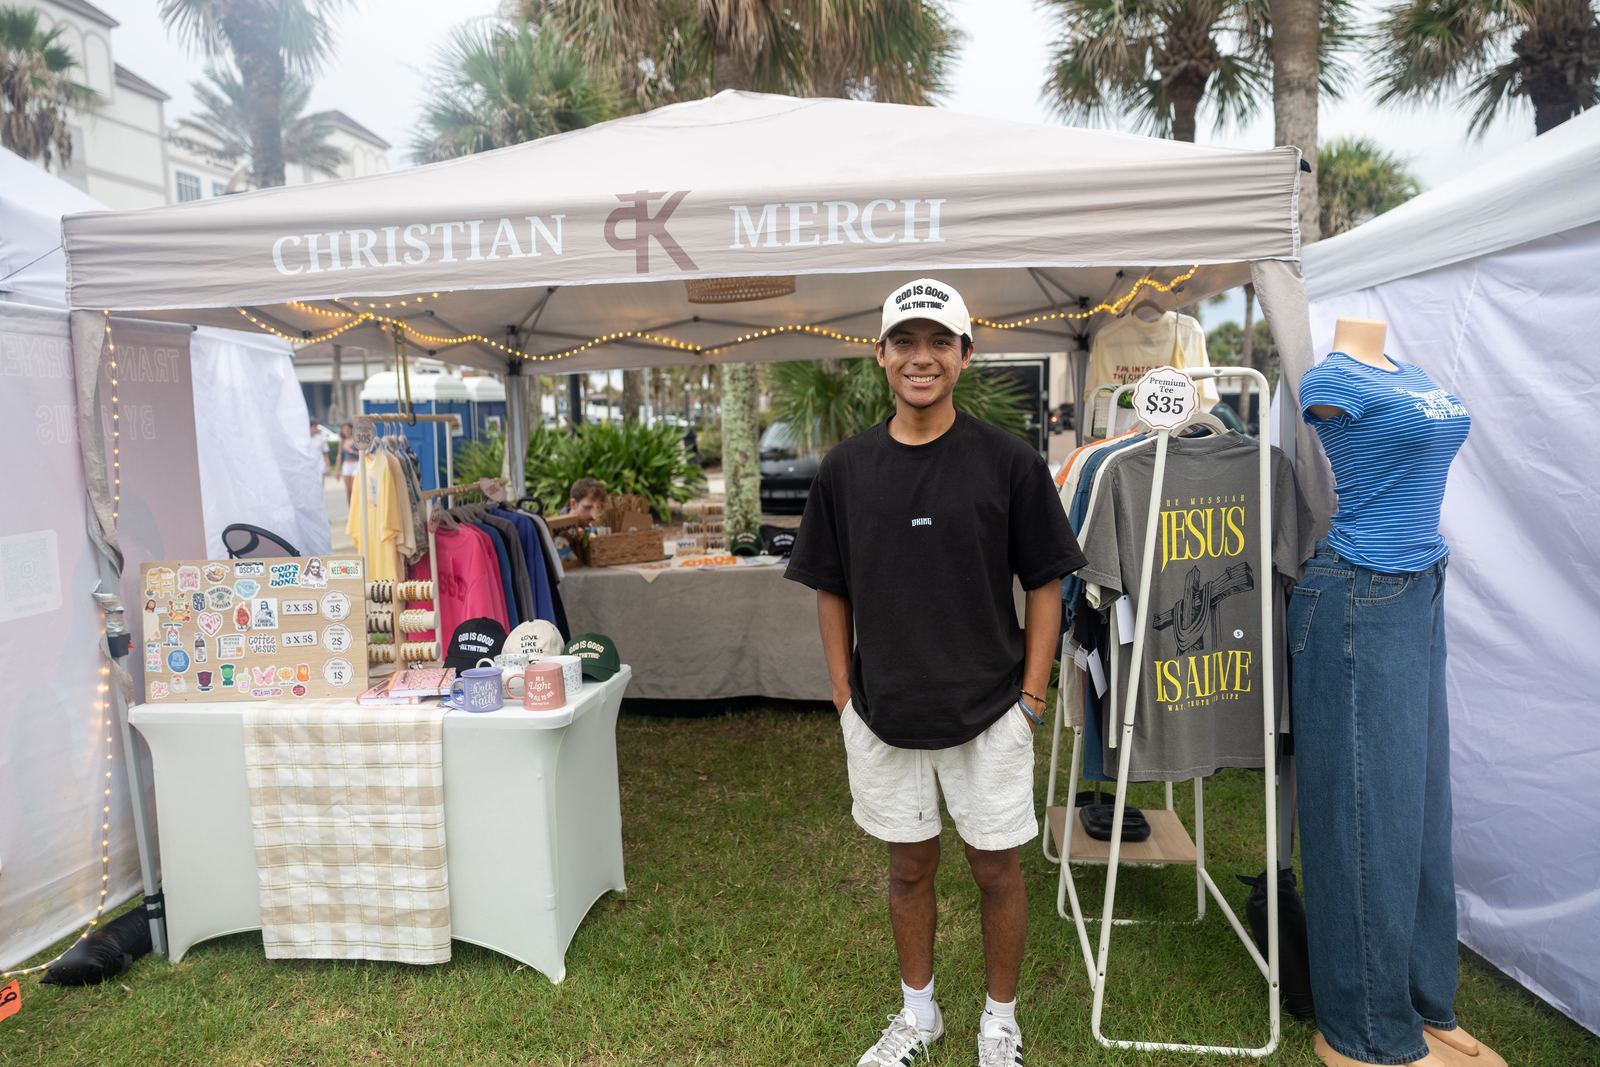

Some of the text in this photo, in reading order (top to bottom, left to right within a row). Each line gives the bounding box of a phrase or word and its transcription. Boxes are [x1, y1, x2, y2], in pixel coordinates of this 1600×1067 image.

[271, 214, 567, 277] CHRISTIAN
[728, 198, 947, 249] MERCH
[895, 284, 949, 305] GOD IS GOOD
[1149, 376, 1186, 388] Premium
[1159, 386, 1174, 394] Tee
[1145, 392, 1185, 415] $35
[1165, 494, 1246, 507] HE MESSIAH
[1160, 505, 1246, 574] JESUS
[271, 564, 299, 573] GOD'S
[278, 571, 298, 580] NOT
[286, 603, 313, 613] 2 X 5$
[329, 604, 341, 613] 3$
[248, 633, 276, 645] Coffee
[286, 634, 313, 644] 3 X 5$
[331, 637, 343, 646] 2$
[458, 632, 495, 647] GOD IS GOOD
[579, 640, 587, 649] IS
[587, 641, 605, 653] GOOD
[333, 671, 343, 680] 1$
[1153, 649, 1252, 703] IS ALIVE
[528, 681, 552, 692] Light
